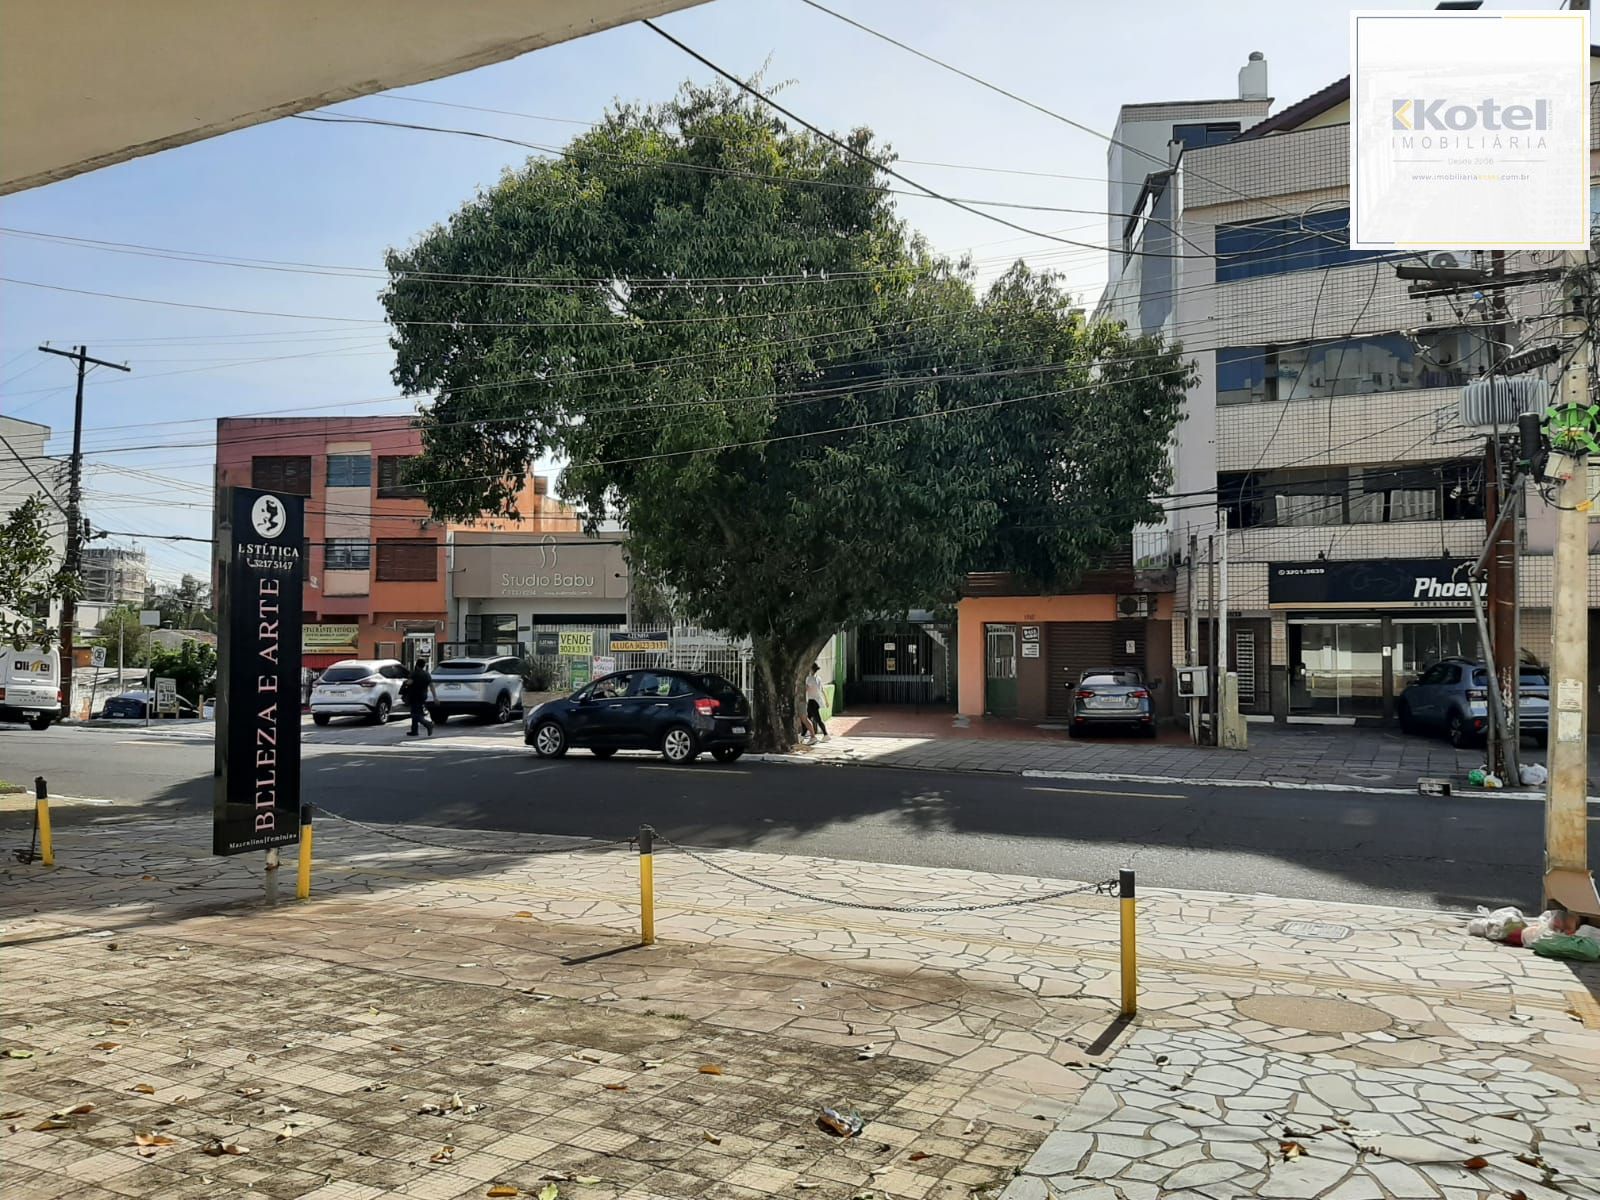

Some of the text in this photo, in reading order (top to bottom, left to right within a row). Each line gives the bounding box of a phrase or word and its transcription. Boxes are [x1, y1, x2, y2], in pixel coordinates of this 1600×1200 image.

[554, 573, 594, 587] Babu
[560, 634, 592, 645] VENDE
[255, 578, 279, 832] BELEZA E ARTE
